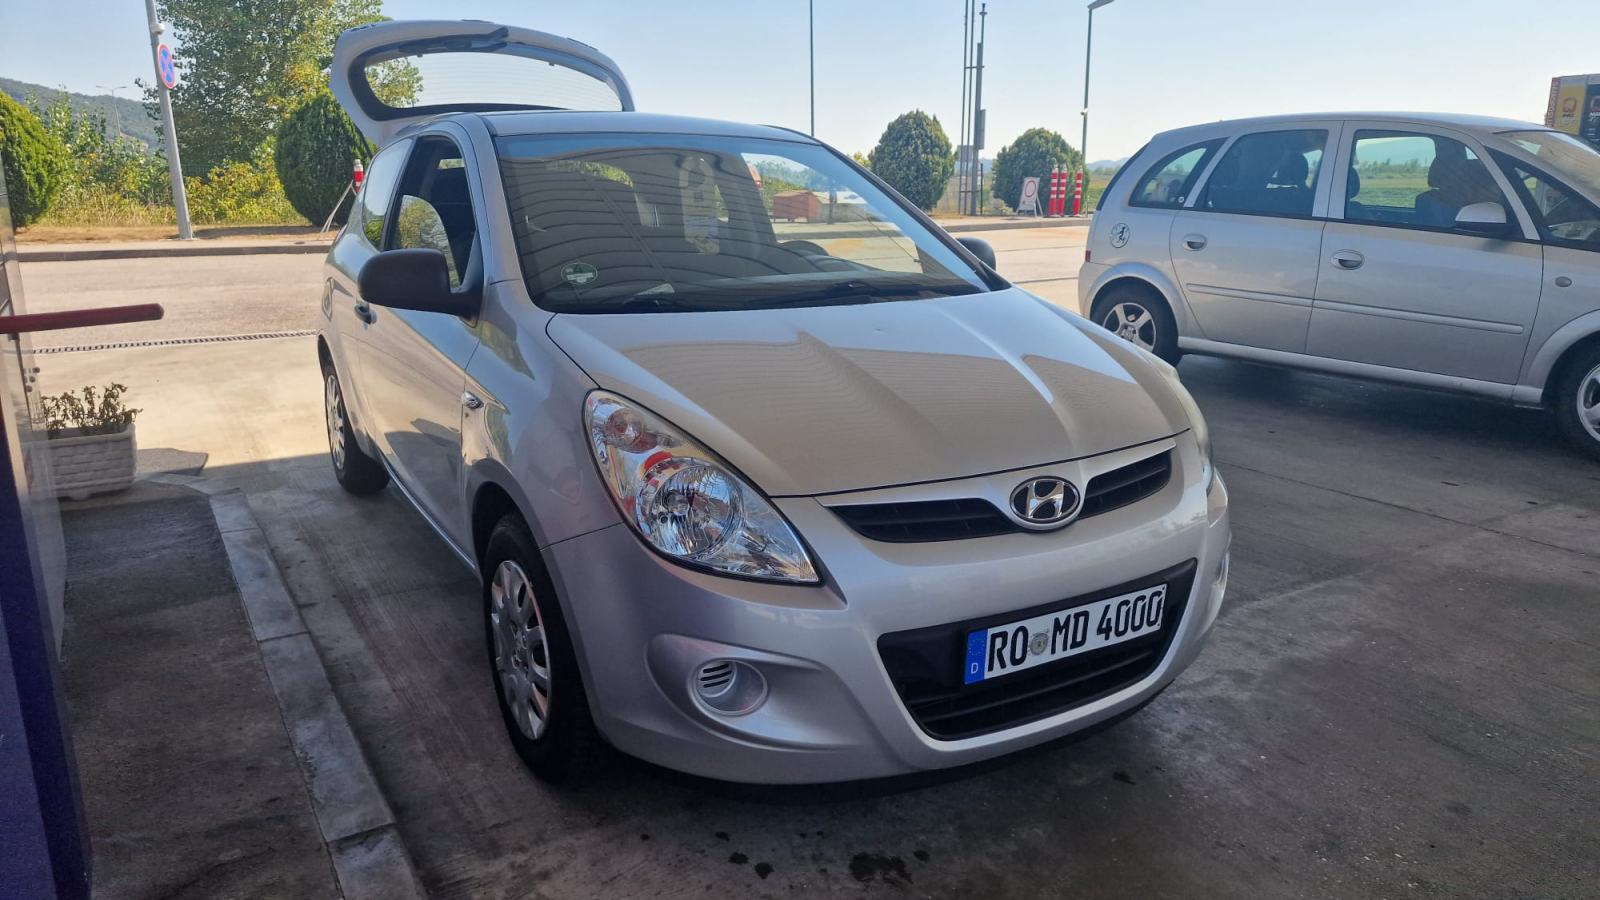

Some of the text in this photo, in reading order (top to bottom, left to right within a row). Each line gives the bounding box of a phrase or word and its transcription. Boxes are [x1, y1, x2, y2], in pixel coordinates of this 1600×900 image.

[988, 591, 1163, 672] RO MD 4000
[970, 662, 978, 674] D
